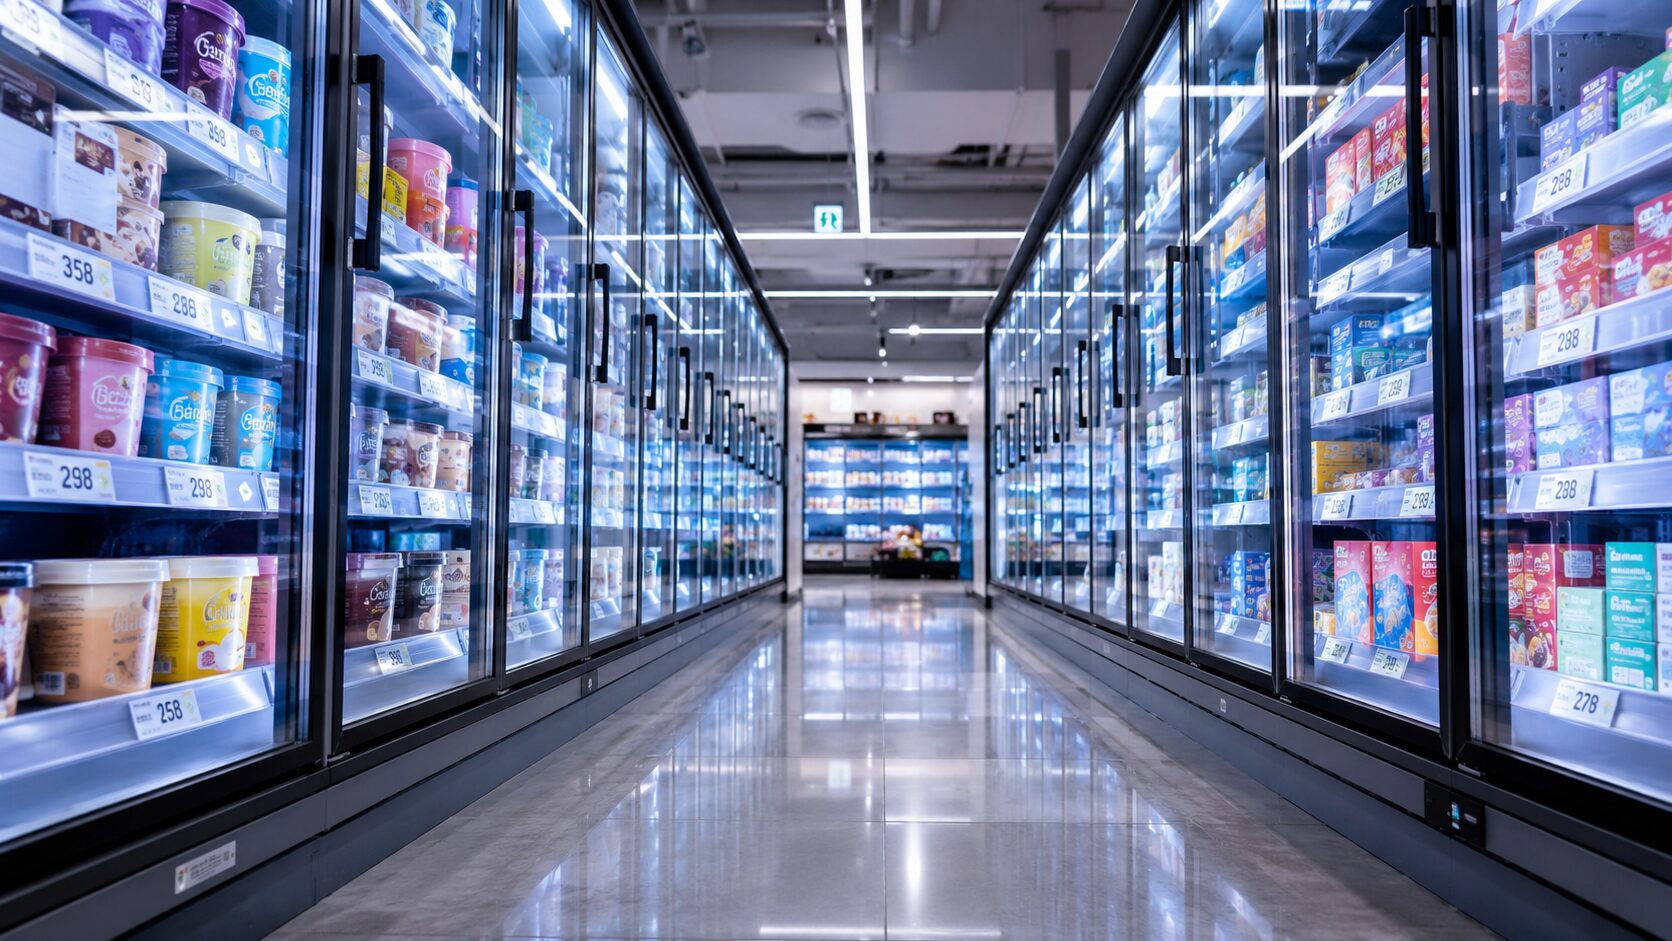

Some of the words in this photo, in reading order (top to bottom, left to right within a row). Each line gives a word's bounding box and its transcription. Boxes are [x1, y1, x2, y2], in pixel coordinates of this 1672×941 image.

[1550, 168, 1573, 196] 288
[62, 254, 95, 286] 358
[172, 292, 198, 319] 288
[1557, 327, 1580, 353] 288
[60, 465, 94, 491] 298
[190, 476, 213, 499] 298
[1555, 479, 1578, 501] 288
[157, 698, 184, 724] 258
[1573, 690, 1600, 715] 278
